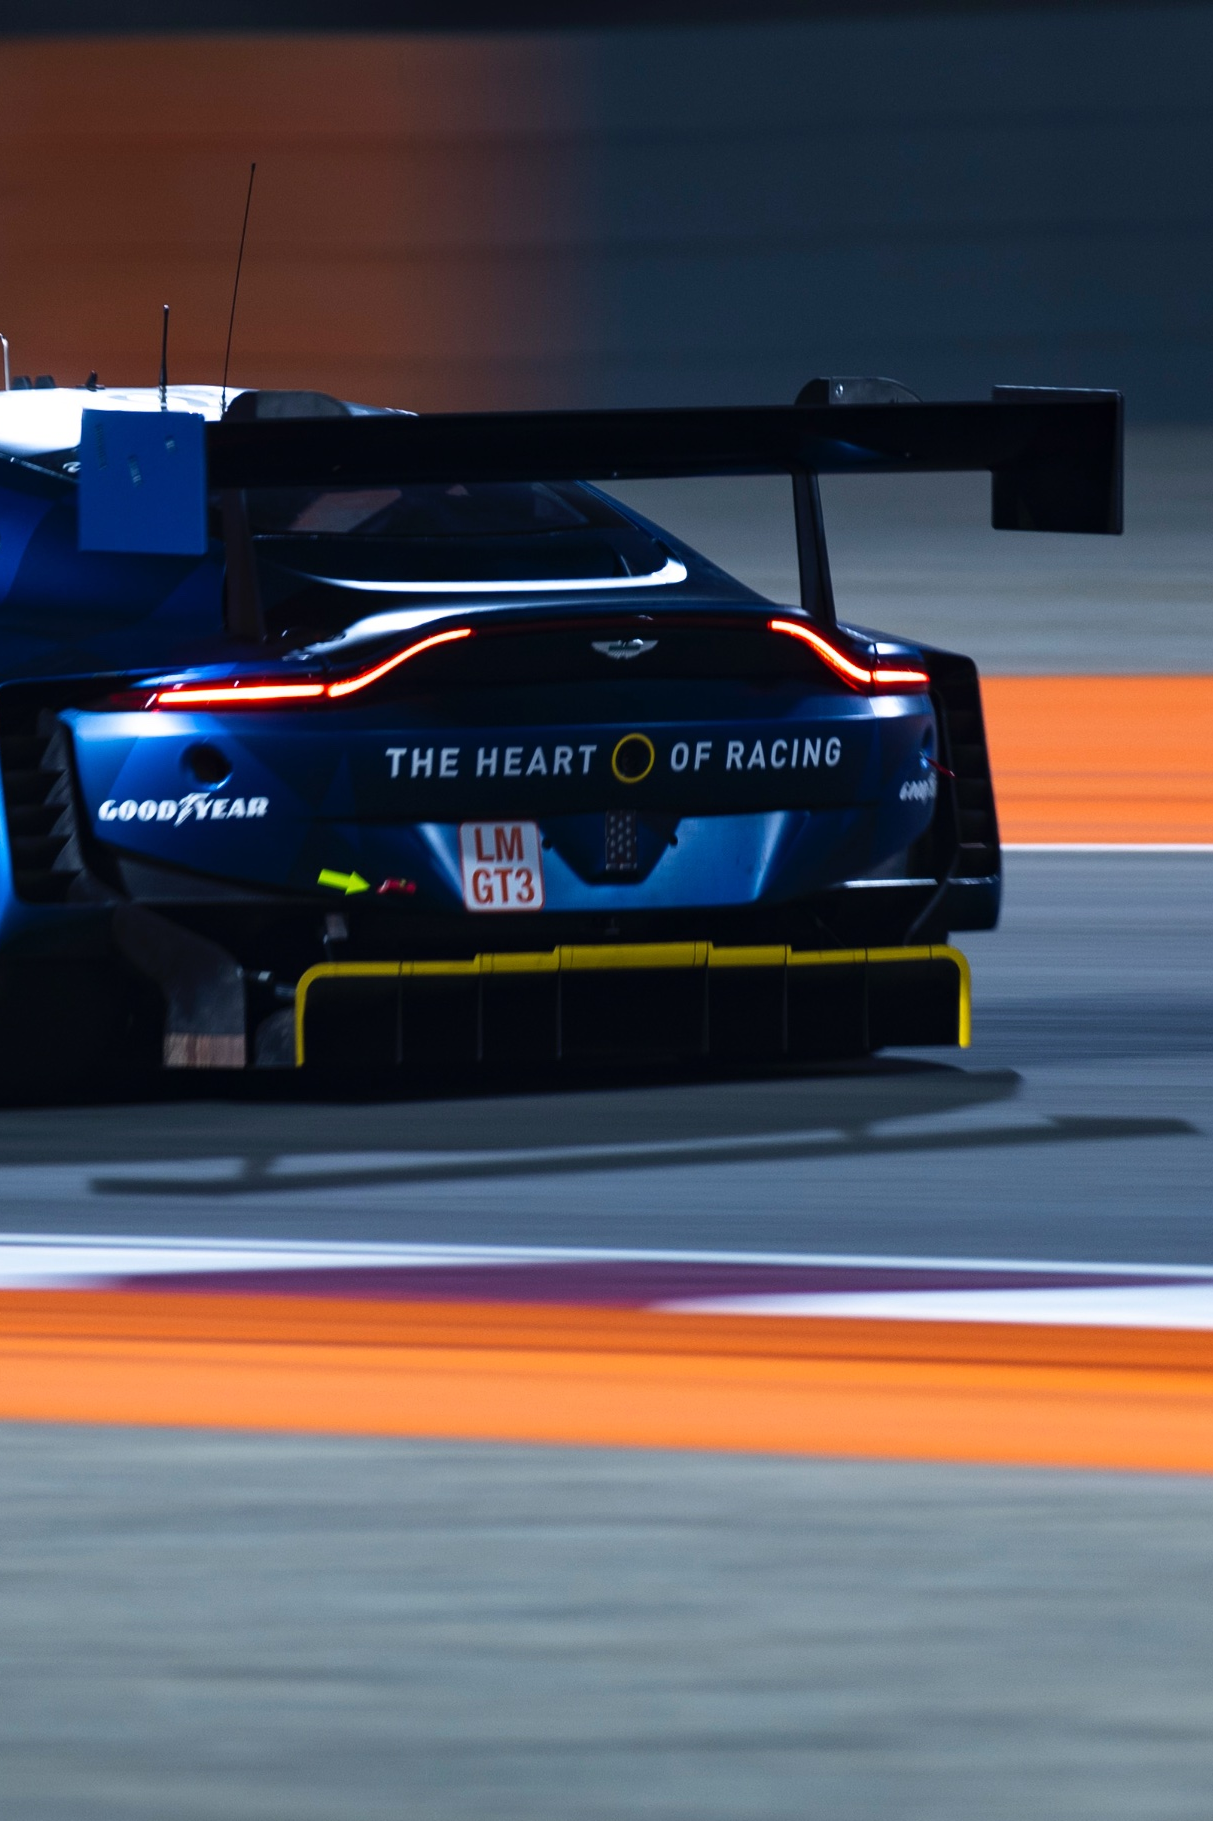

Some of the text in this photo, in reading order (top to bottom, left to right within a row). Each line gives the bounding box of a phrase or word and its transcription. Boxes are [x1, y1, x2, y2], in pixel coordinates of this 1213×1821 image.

[385, 737, 843, 778] THE HEART OF RACING
[98, 793, 270, 827] GOODYEAR
[474, 826, 524, 862] LM
[472, 867, 535, 905] GT3
